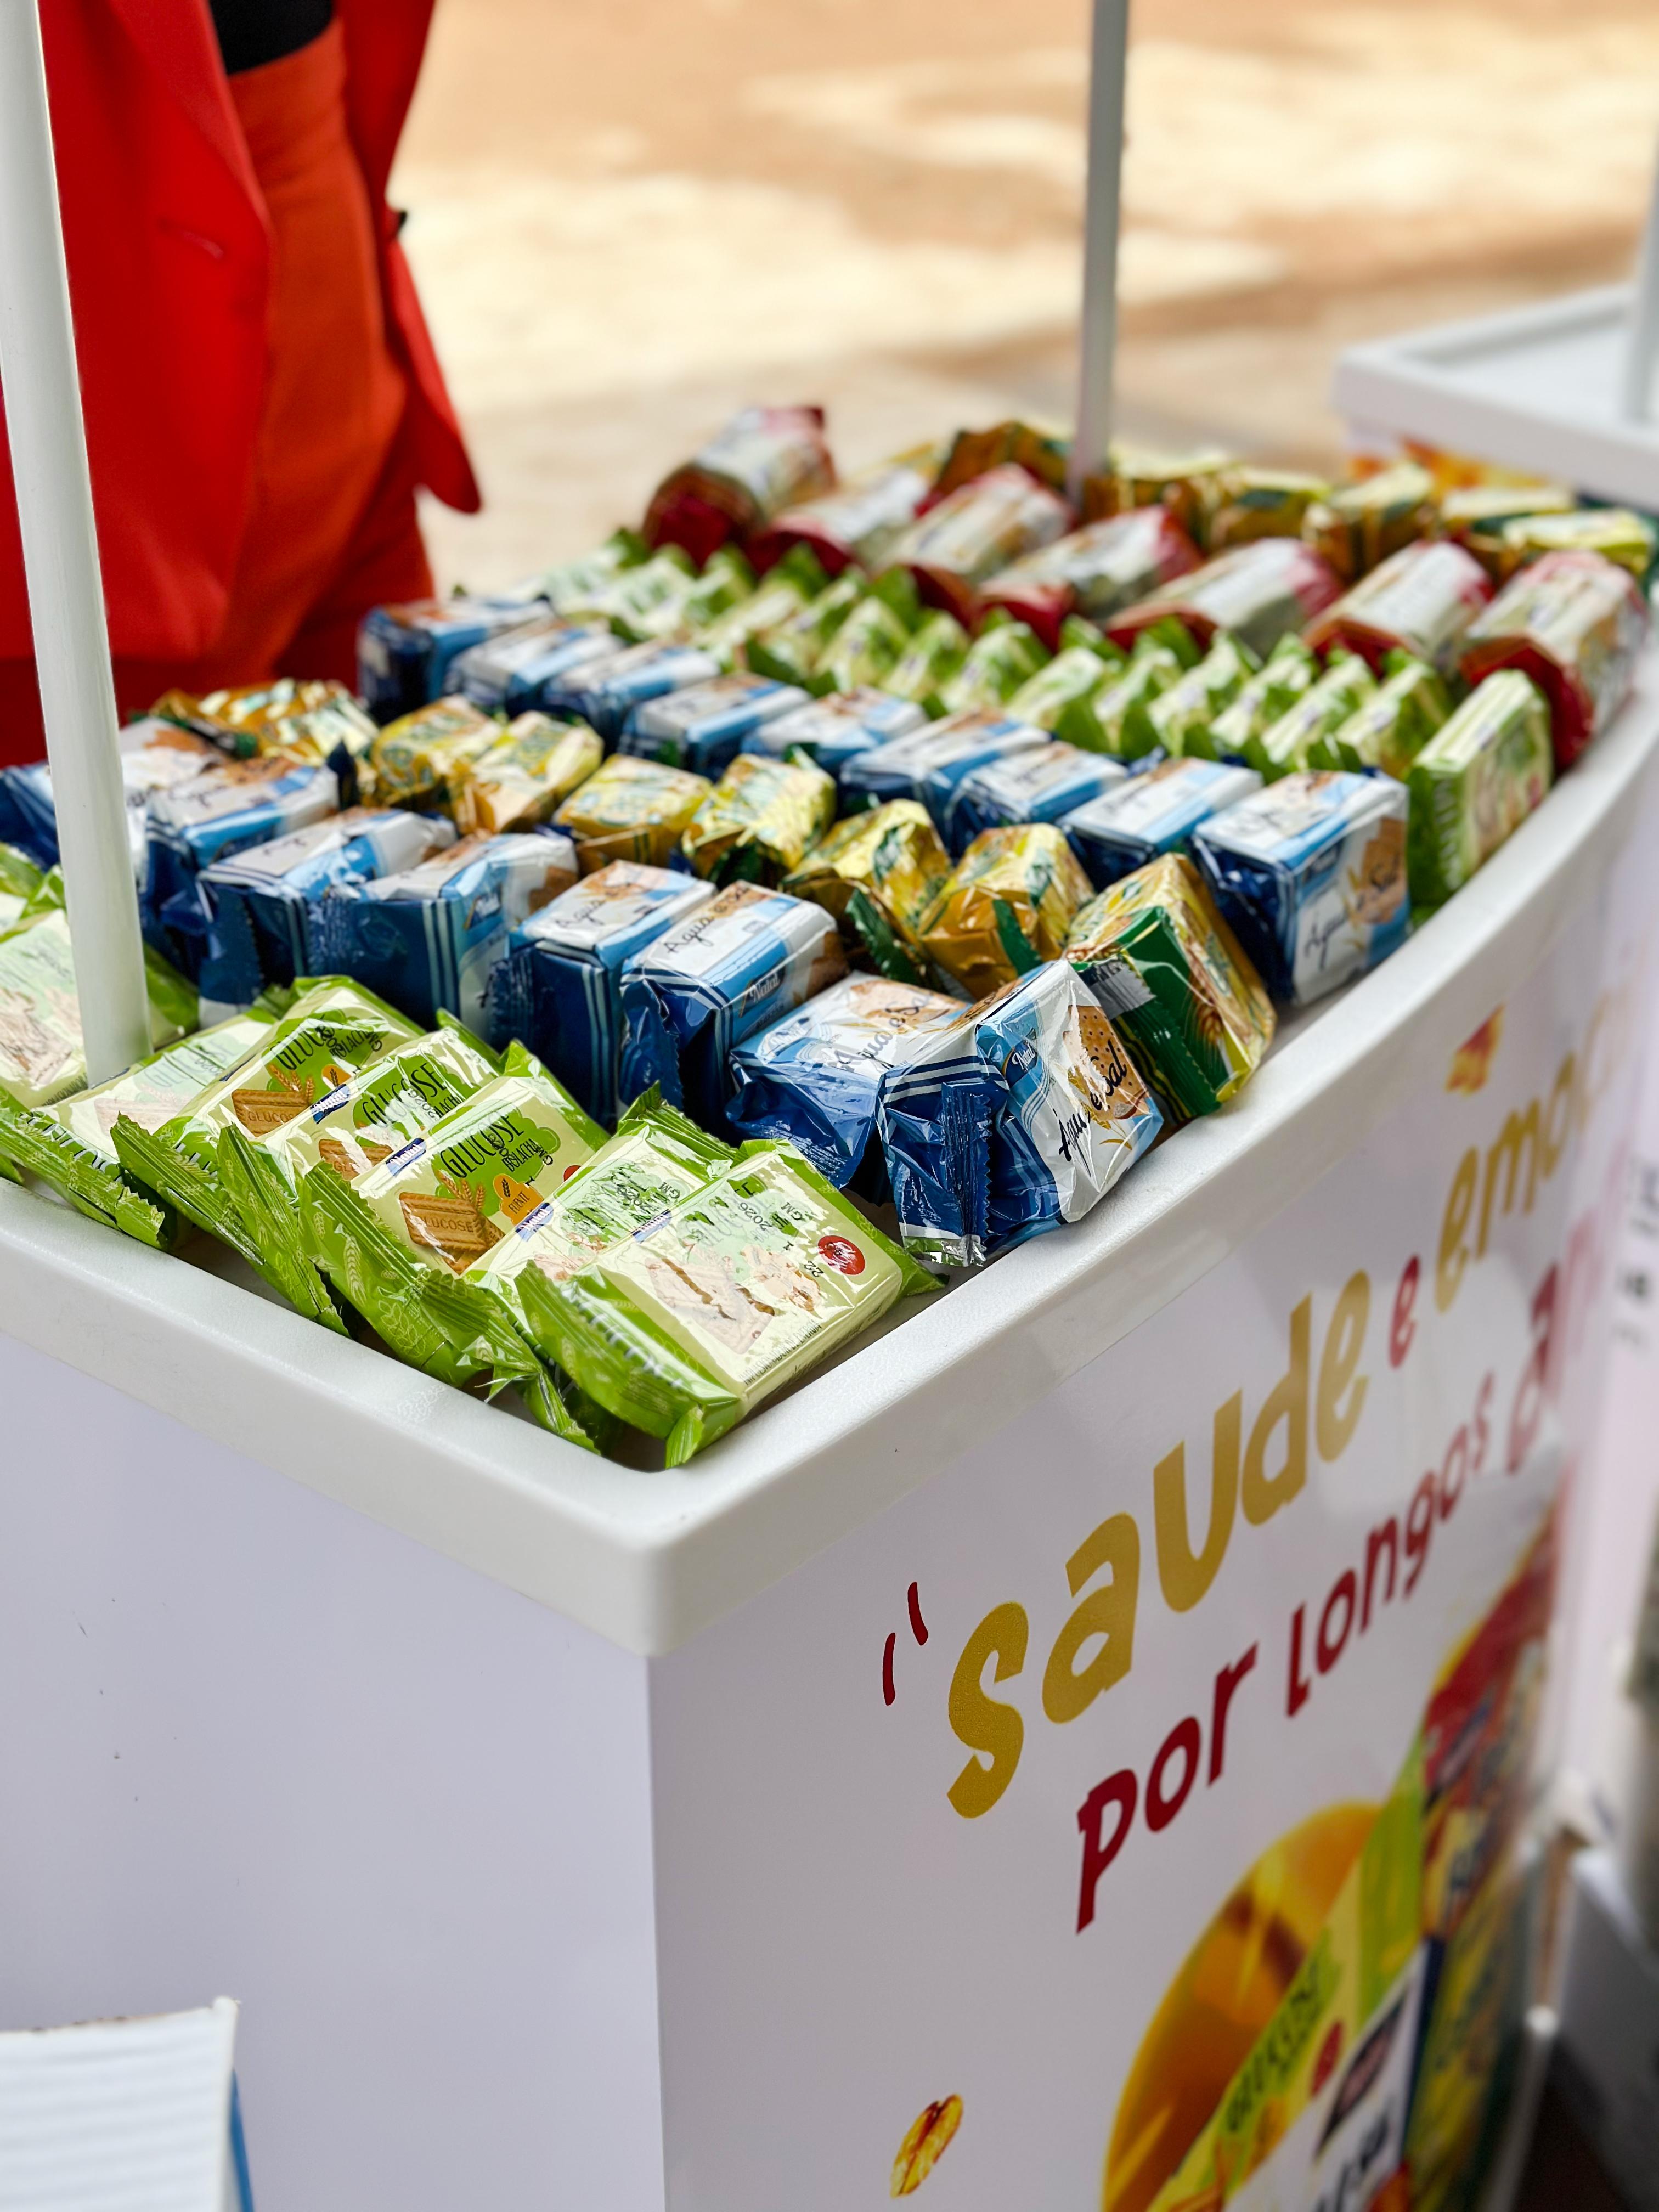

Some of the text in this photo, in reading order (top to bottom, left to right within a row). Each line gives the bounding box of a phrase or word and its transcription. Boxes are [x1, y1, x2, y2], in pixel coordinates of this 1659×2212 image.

[663, 916, 714, 953] Agua
[749, 972, 781, 1003] Natal
[1012, 1042, 1037, 1072] Natal
[363, 1062, 447, 1128] GLUCOSE
[1090, 1091, 1104, 1111] e
[248, 1110, 293, 1124] GLUCOS
[440, 1109, 524, 1178] GLUCOSE
[501, 1138, 543, 1172] BOLACHA
[508, 1190, 531, 1215] FUENTE
[658, 1181, 681, 1200] GM
[738, 1201, 774, 1232] 2026
[780, 1200, 804, 1221] GM
[804, 1260, 825, 1278] 22
[1390, 1254, 1420, 1369] e
[1076, 1640, 1259, 1936] por
[1286, 1370, 1494, 1719] longos
